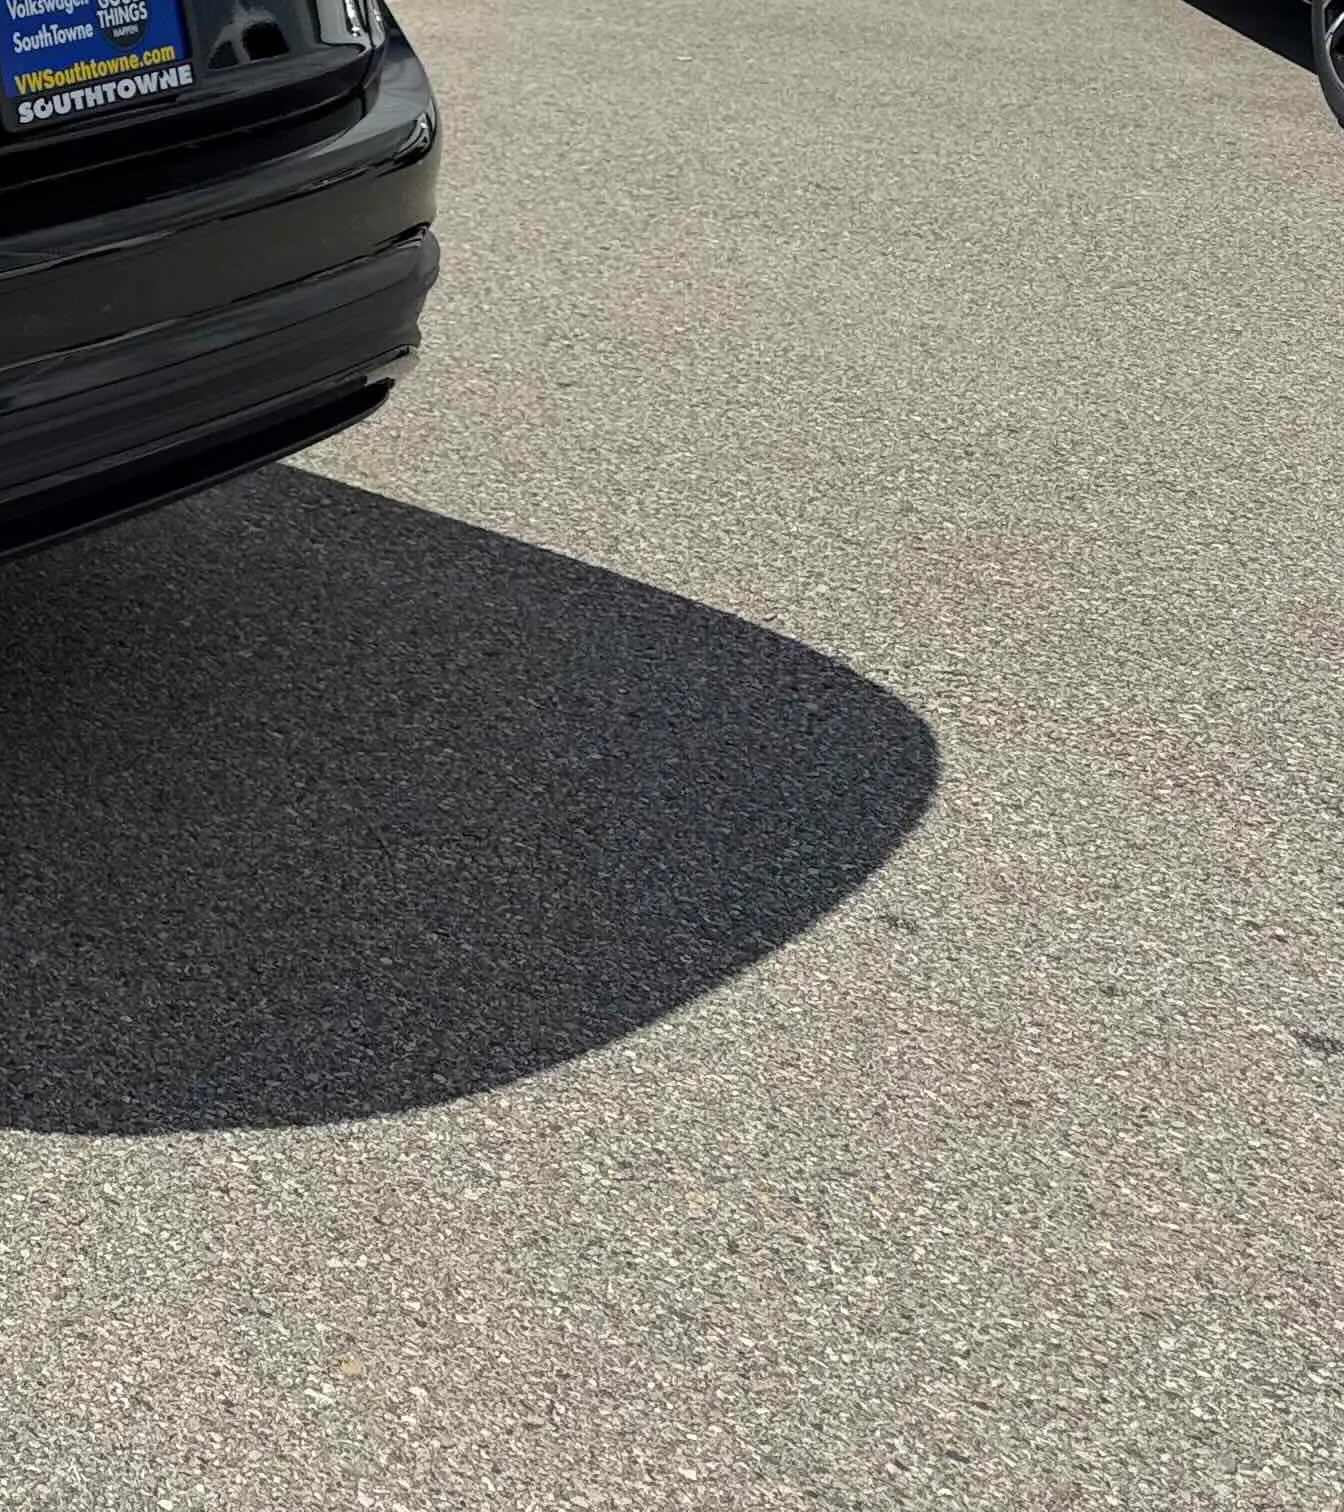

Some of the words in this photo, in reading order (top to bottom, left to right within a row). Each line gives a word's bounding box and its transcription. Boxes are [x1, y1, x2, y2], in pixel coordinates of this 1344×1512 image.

[96, 1, 148, 29] THINGS
[12, 23, 95, 54] SouthTowne
[14, 44, 176, 95] VWSouthtowne.com
[17, 63, 194, 124] SOUTHTOWNE
